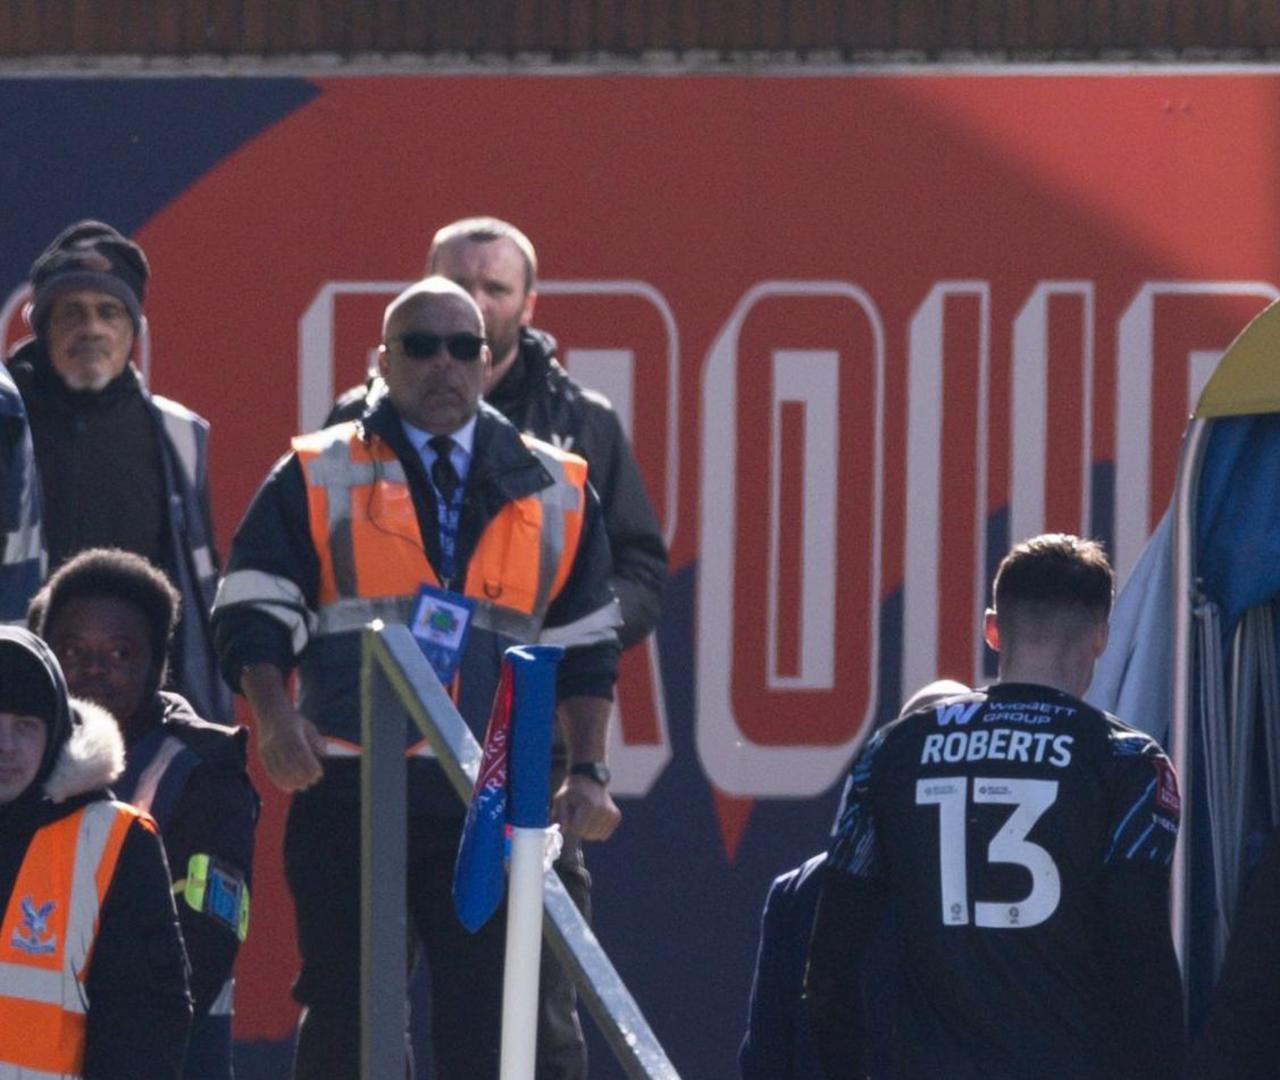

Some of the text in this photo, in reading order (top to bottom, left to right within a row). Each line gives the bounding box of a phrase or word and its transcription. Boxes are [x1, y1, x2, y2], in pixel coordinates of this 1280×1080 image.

[982, 711, 1053, 725] GROUP
[920, 728, 1075, 768] ROBERTS
[915, 776, 1061, 929] 13
